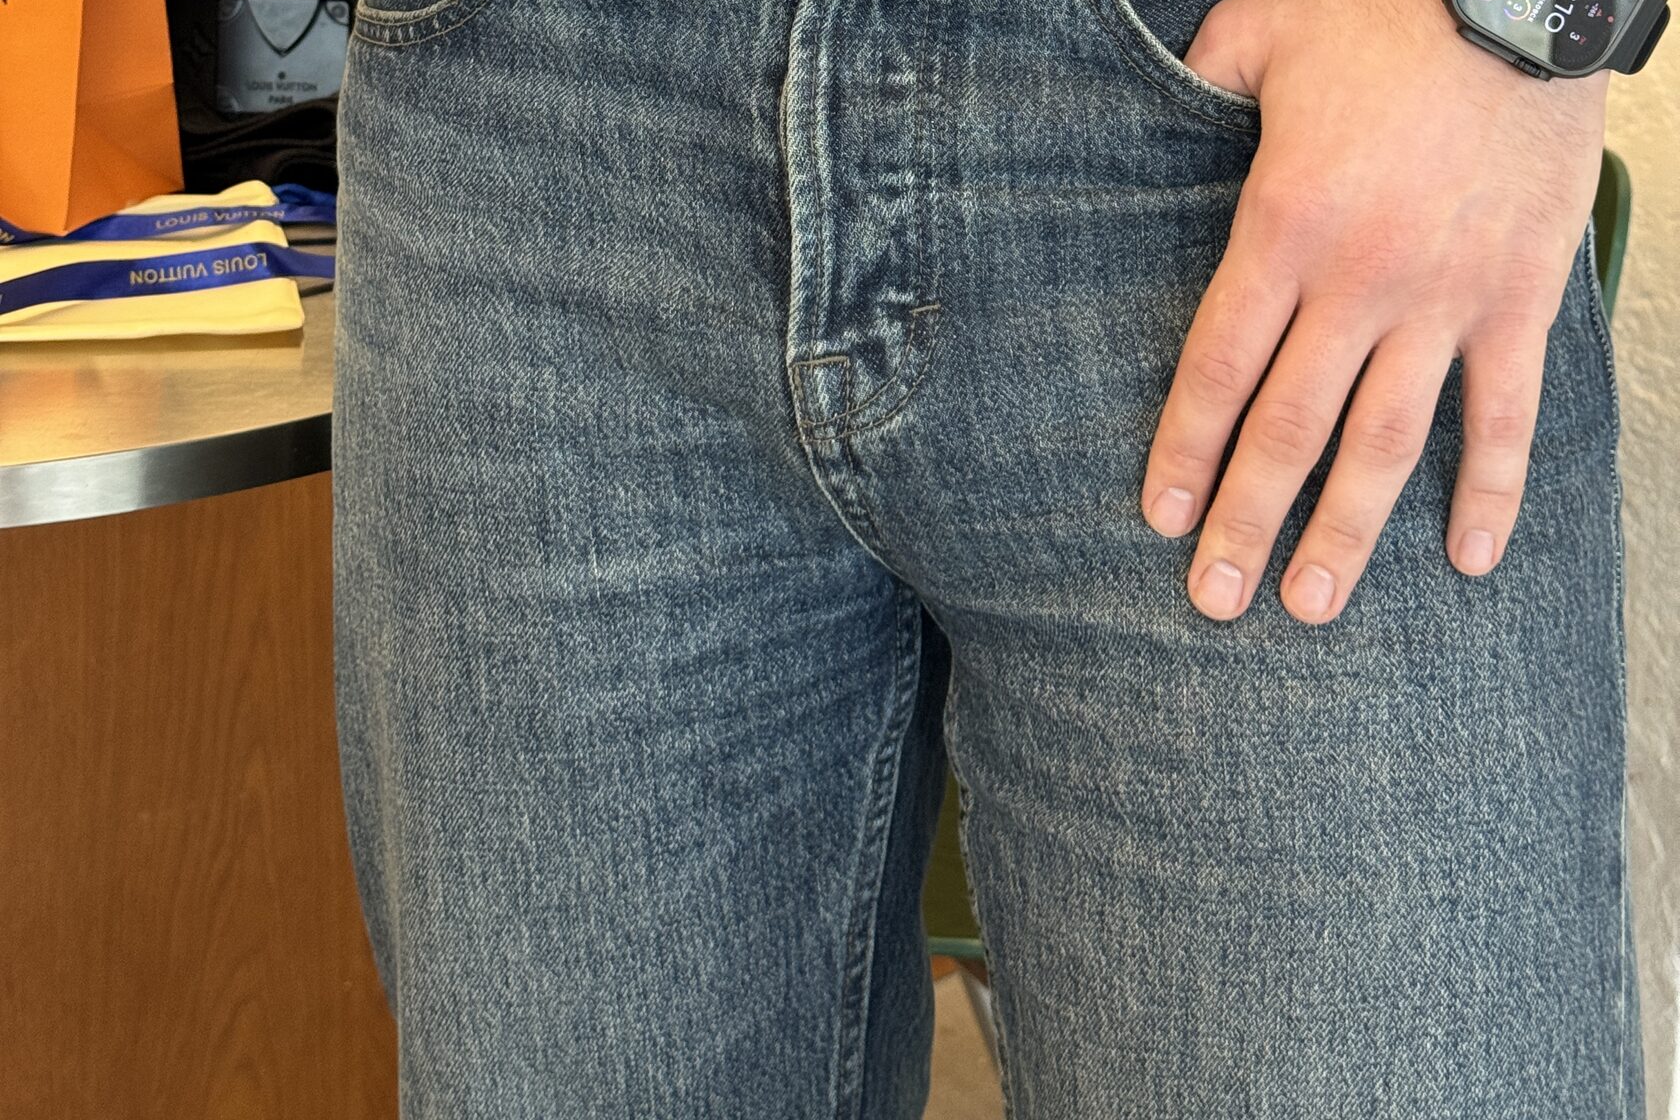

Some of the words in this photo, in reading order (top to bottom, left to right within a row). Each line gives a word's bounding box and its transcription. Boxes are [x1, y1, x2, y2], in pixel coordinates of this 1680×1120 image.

[1513, 3, 1523, 12] 3
[1569, 31, 1580, 41] 3
[155, 211, 209, 229] LOUIS
[212, 252, 267, 275] LOUIS
[129, 262, 208, 286] VUITTON
